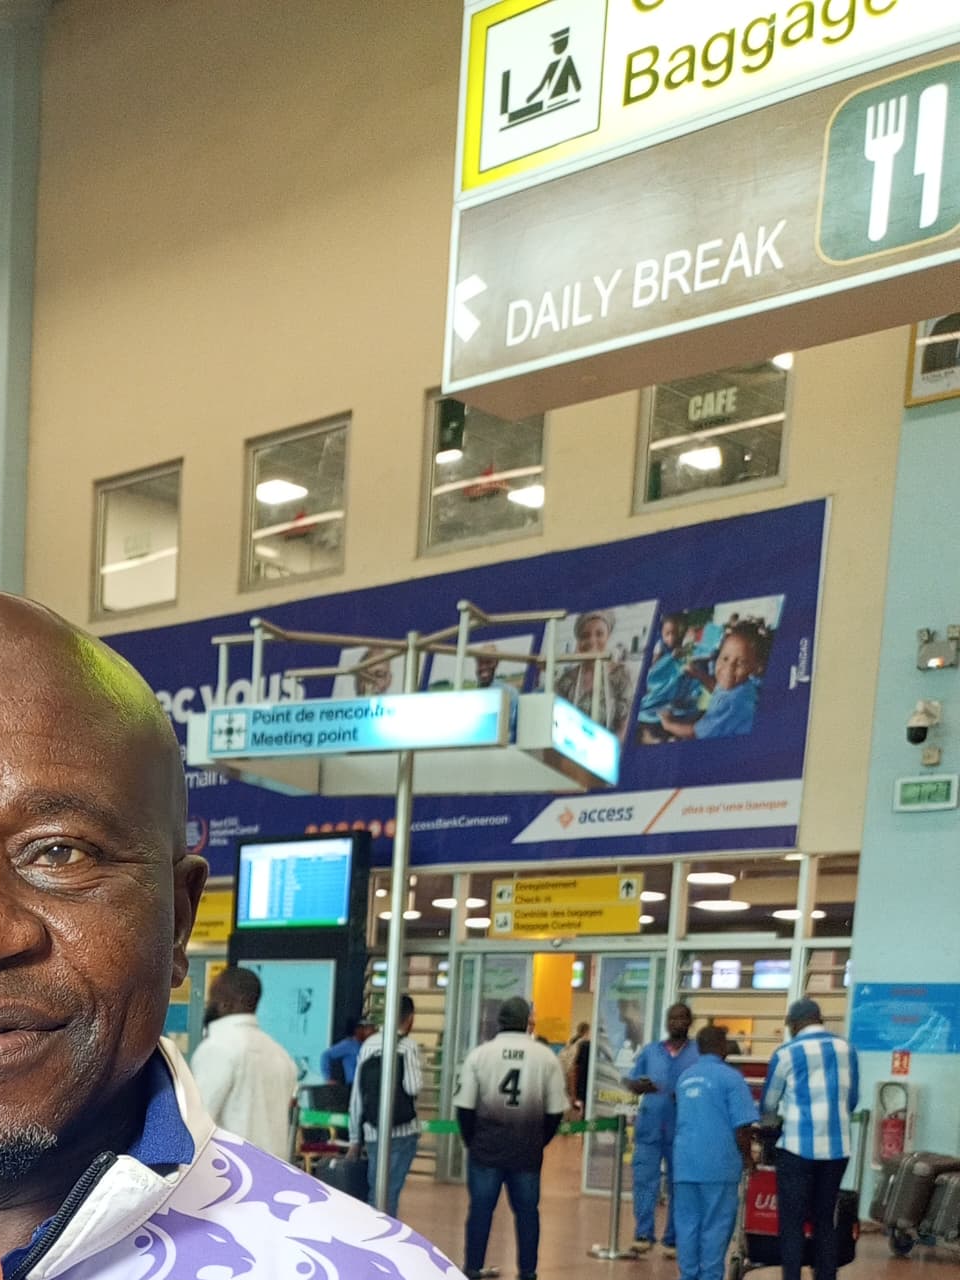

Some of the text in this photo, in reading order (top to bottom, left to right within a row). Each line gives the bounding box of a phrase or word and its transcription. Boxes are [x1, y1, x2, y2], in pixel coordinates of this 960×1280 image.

[506, 219, 787, 347] DAILY BREAK
[252, 708, 290, 725] Point
[295, 706, 314, 722] de
[251, 728, 359, 748] Meeting point
[578, 806, 634, 825] access
[498, 1067, 522, 1107] 4
